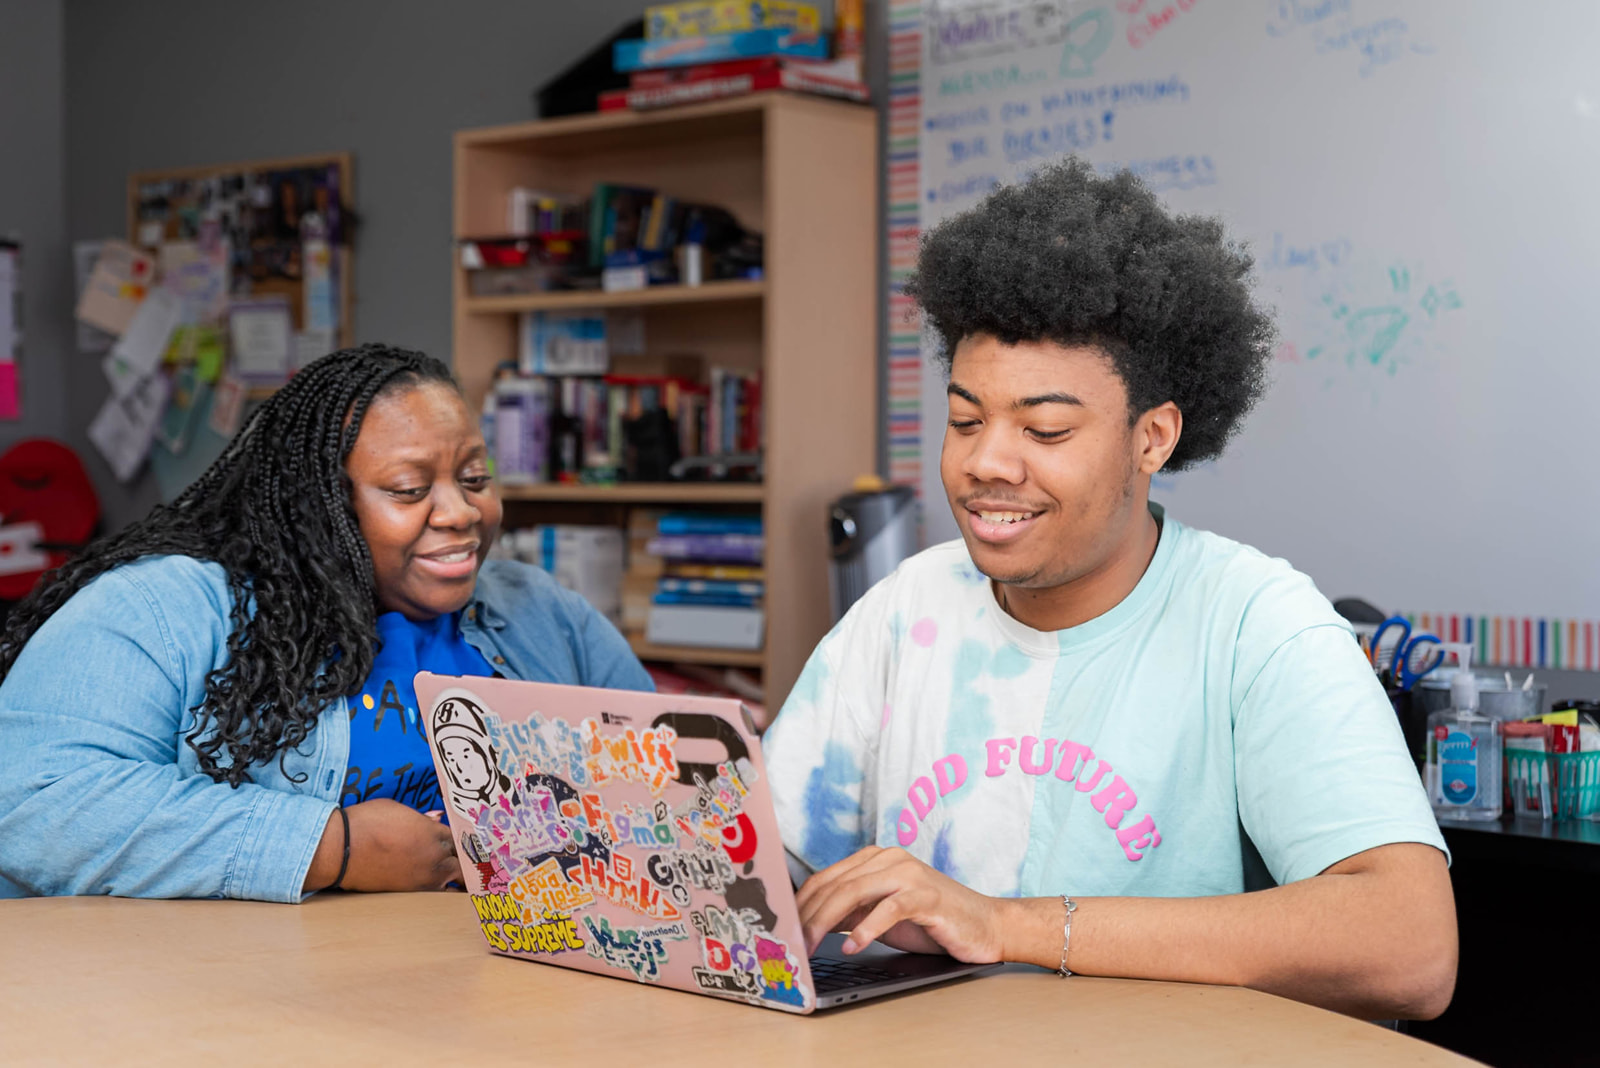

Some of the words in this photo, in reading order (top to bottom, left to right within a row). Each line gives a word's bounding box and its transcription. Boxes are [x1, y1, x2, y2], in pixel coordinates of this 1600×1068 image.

[581, 794, 675, 845] Figma
[897, 753, 968, 846] ODD
[985, 735, 1162, 862] FUTURE
[480, 921, 508, 953] IS
[503, 919, 585, 955] SUPREME
